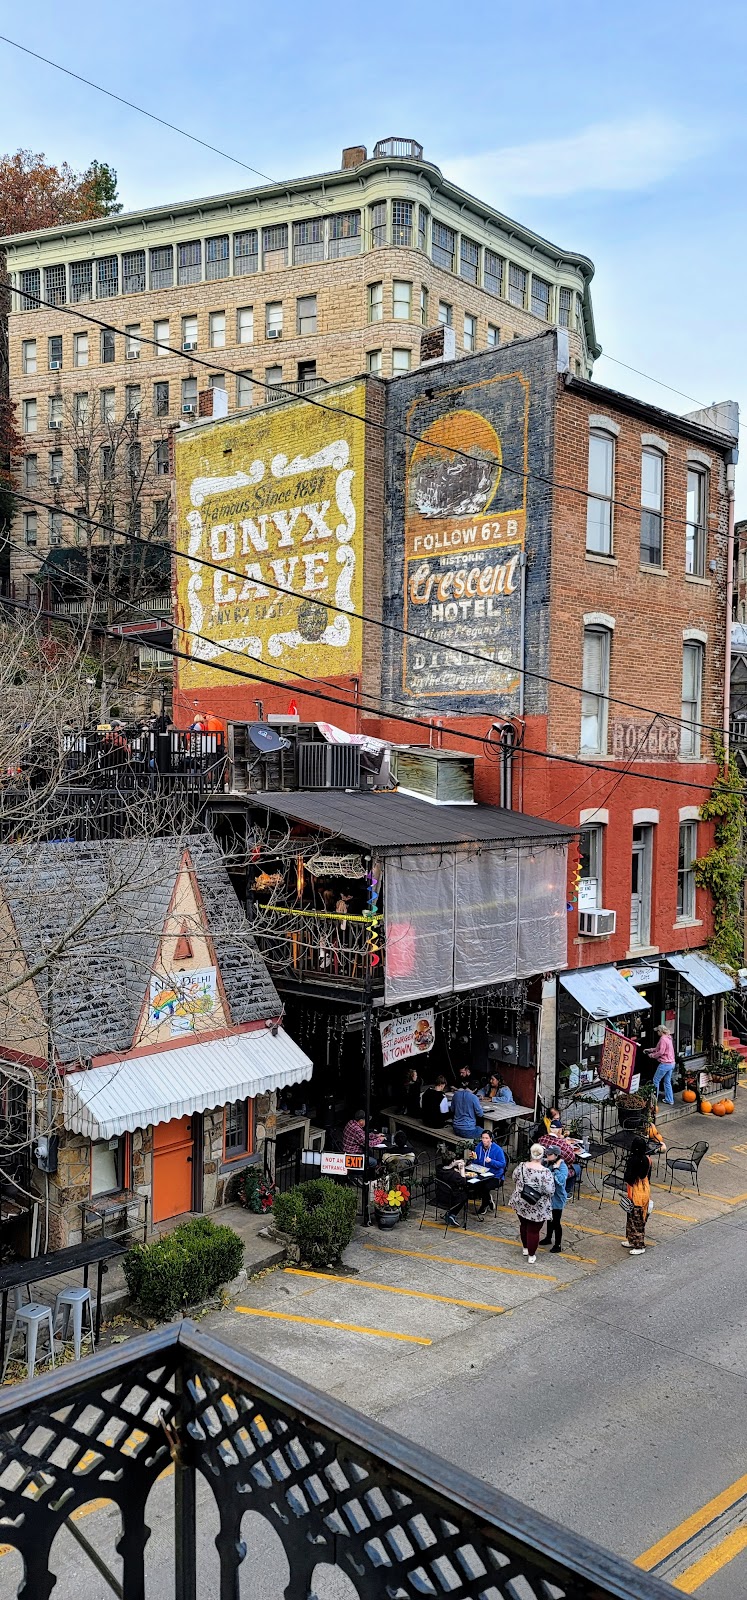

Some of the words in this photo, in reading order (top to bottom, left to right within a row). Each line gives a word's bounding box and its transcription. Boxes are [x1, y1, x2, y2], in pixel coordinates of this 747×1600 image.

[201, 499, 250, 522] Famous
[251, 484, 291, 512] Since
[210, 500, 333, 562] ONYX
[413, 526, 478, 552] FOLLOW
[481, 522, 501, 540] 62
[507, 519, 518, 536] B
[213, 551, 329, 605] CAVE
[409, 554, 520, 605] Crescent
[431, 598, 501, 622] HOTEL
[182, 975, 211, 985] DELHI
[390, 1043, 412, 1060] TOWN
[619, 1043, 630, 1086] OPEN
[346, 1156, 363, 1168] EXIT
